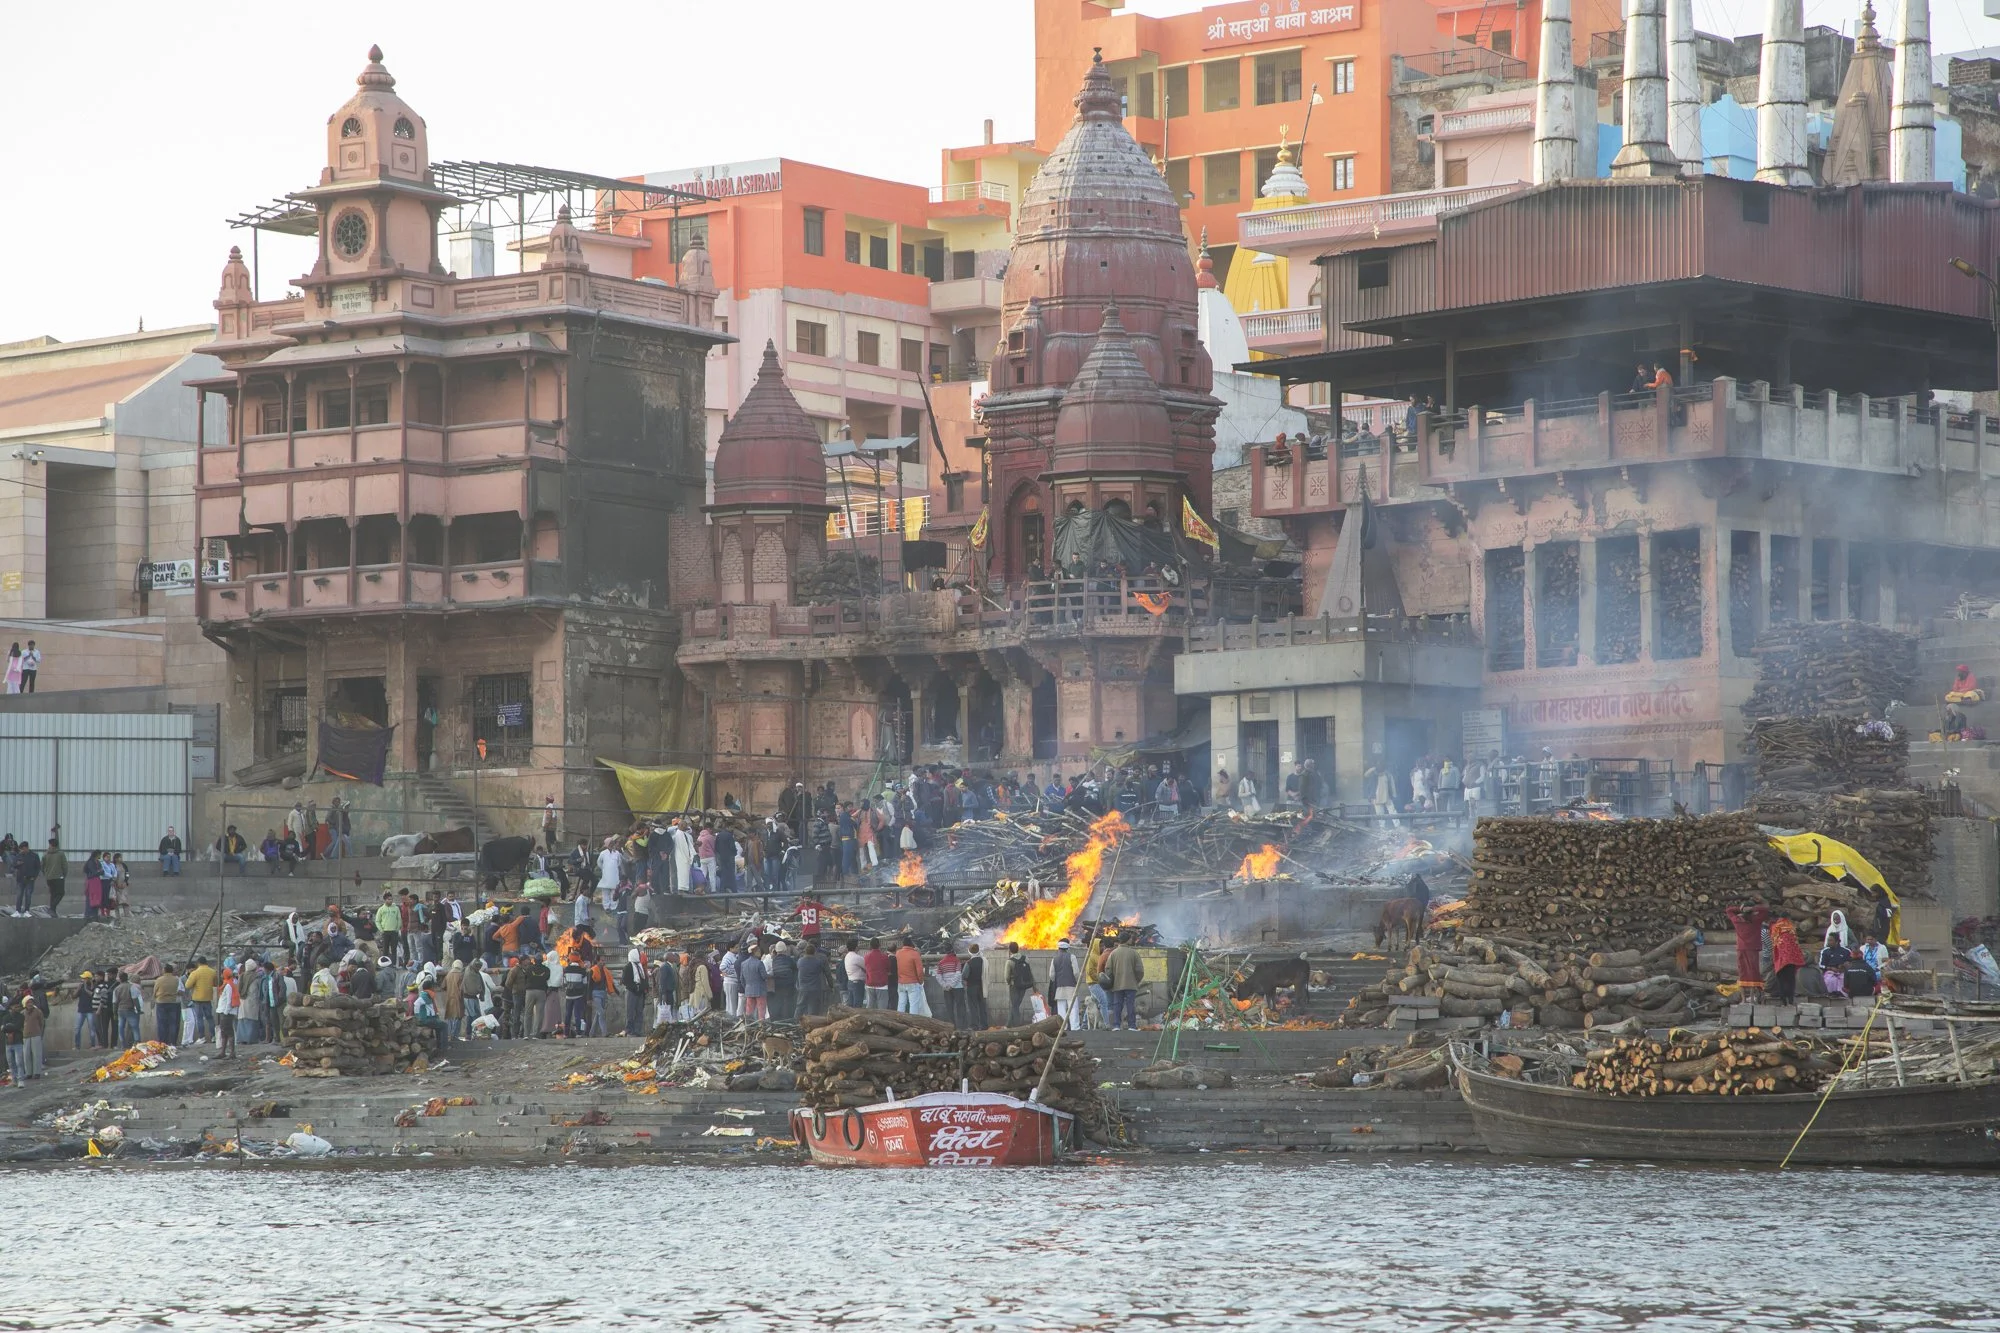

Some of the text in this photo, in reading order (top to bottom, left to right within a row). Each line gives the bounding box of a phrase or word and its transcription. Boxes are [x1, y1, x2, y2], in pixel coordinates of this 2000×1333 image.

[1207, 16, 1226, 40] श्री
[1310, 5, 1354, 25] आश्रम
[706, 177, 735, 198] BABA
[736, 171, 780, 194] ASHRAM
[153, 562, 176, 573] SHIVA
[1622, 692, 1652, 718] नाथ
[801, 908, 817, 925] 89
[920, 1107, 957, 1124] बाबू
[886, 1138, 904, 1151] 0047
[928, 1125, 1003, 1151] किंग
